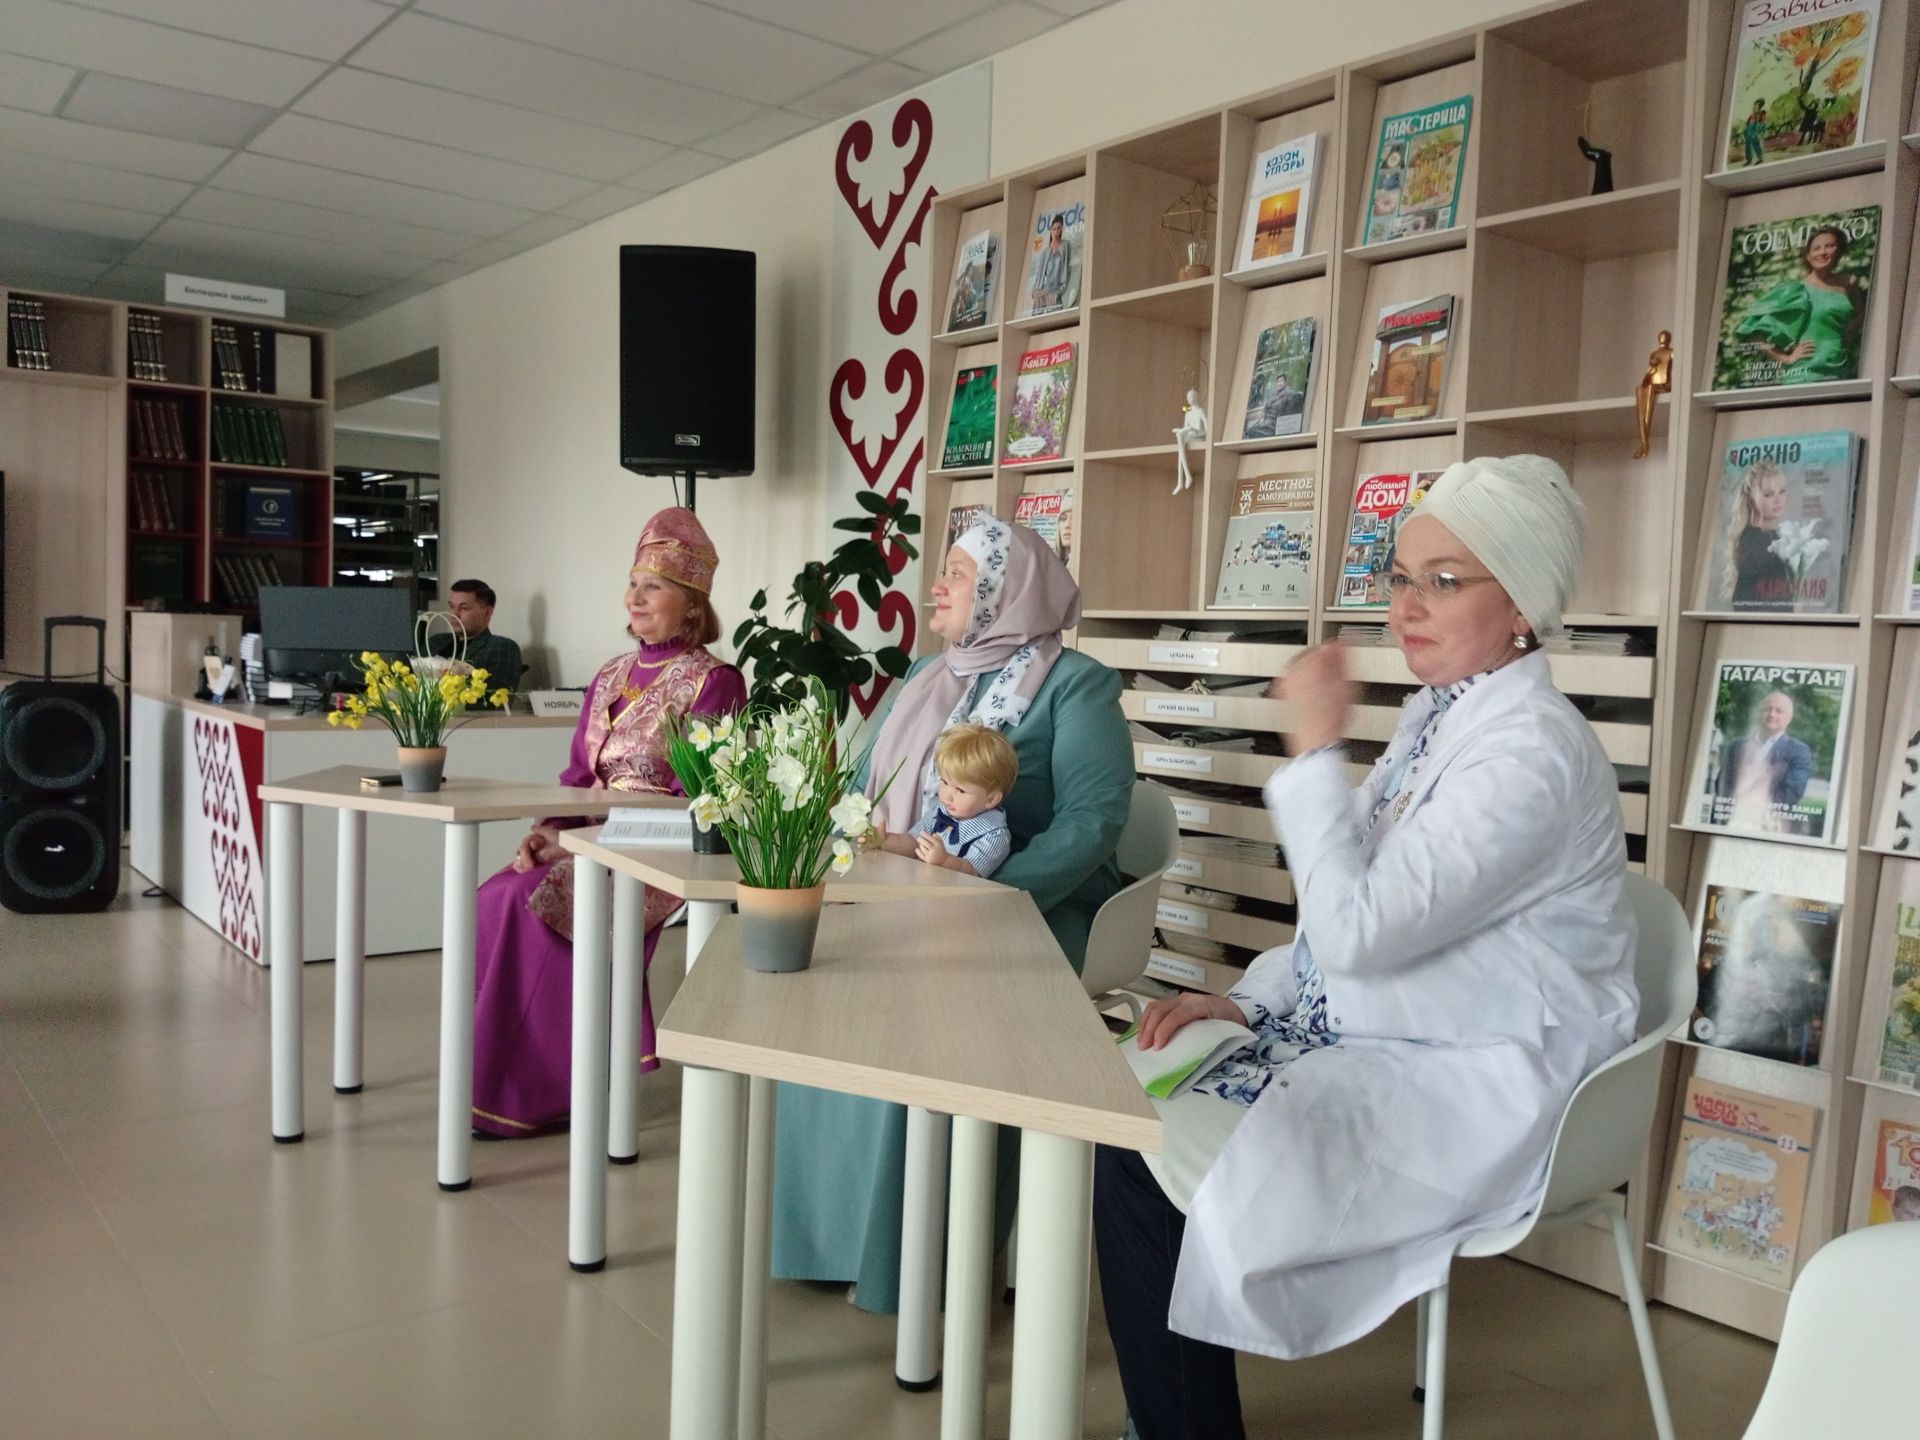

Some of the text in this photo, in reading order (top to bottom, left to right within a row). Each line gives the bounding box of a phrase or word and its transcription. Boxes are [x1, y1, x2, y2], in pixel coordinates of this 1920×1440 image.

[1385, 104, 1466, 138] МАСТЕРИЦА
[1265, 158, 1304, 179] УТЛАРЫ
[1259, 478, 1313, 492] МЕСТНОЕ
[1358, 489, 1406, 509] ДОМ
[1722, 666, 1842, 687] ТАТАРСТАН
[543, 700, 580, 709] НОЯБРЬ
